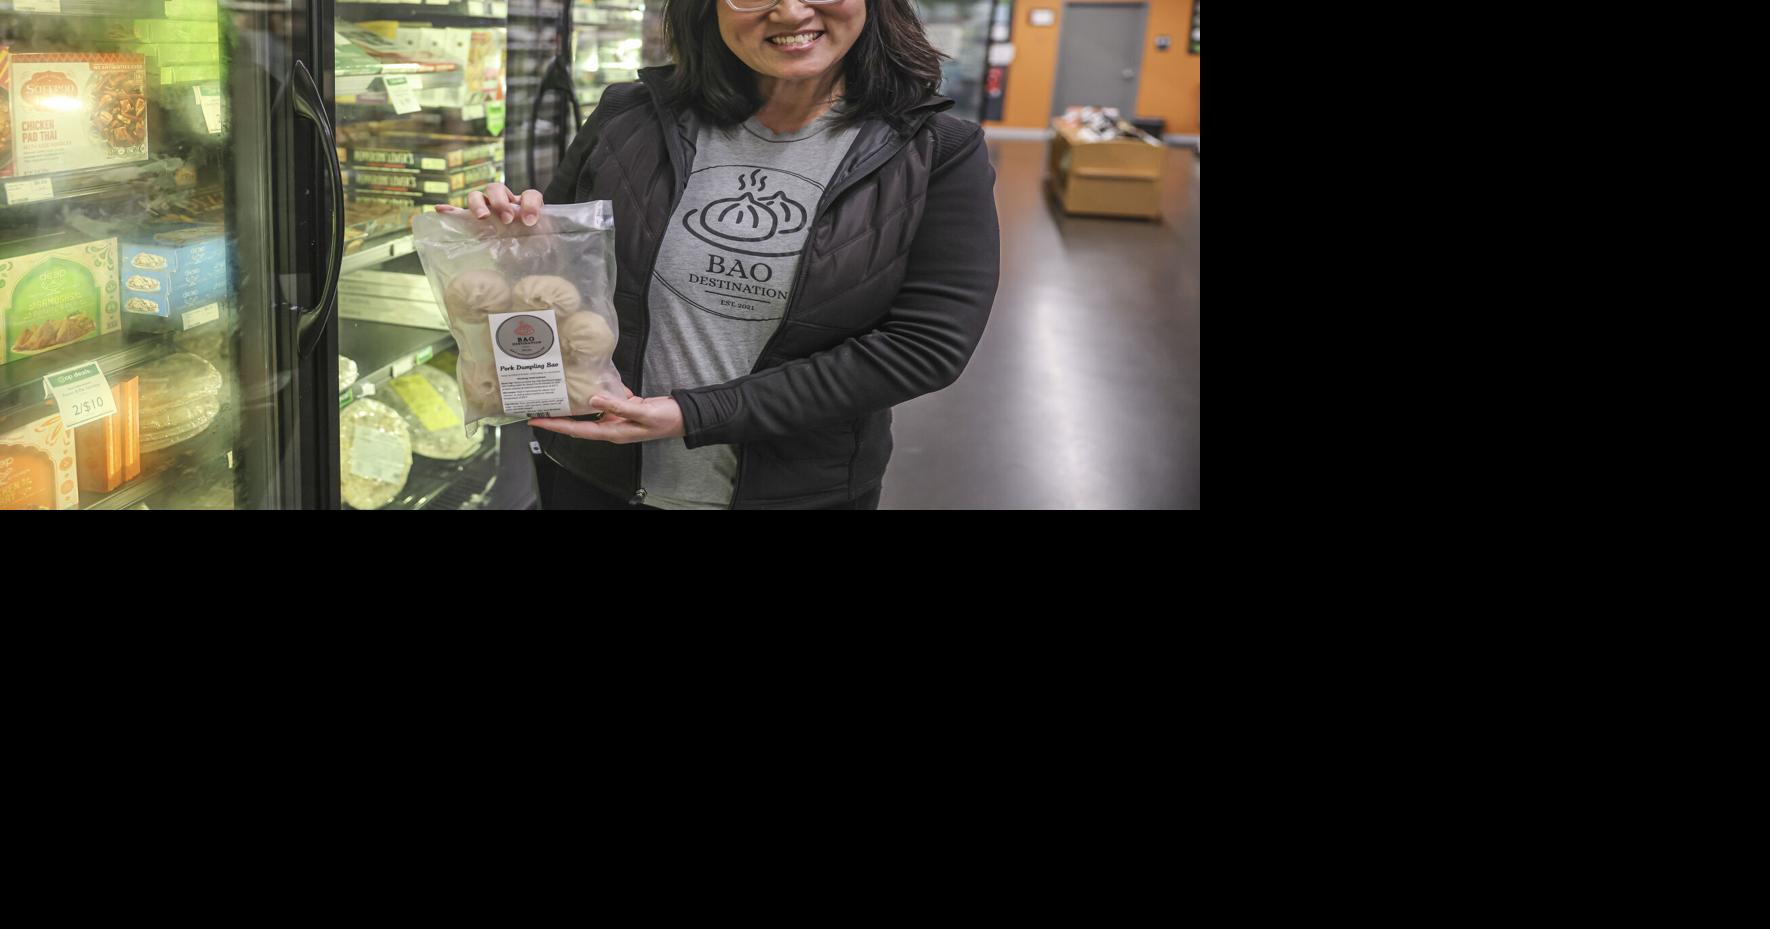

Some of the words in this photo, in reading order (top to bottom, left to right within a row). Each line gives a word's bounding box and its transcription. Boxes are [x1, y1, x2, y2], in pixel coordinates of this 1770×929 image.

[22, 119, 55, 132] CHICKEN
[22, 132, 39, 143] PAD
[40, 130, 57, 142] THAI
[705, 254, 773, 283] BAO
[688, 273, 788, 300] DESTINATION
[737, 303, 755, 311] 2021
[71, 396, 104, 417] 2/$10
